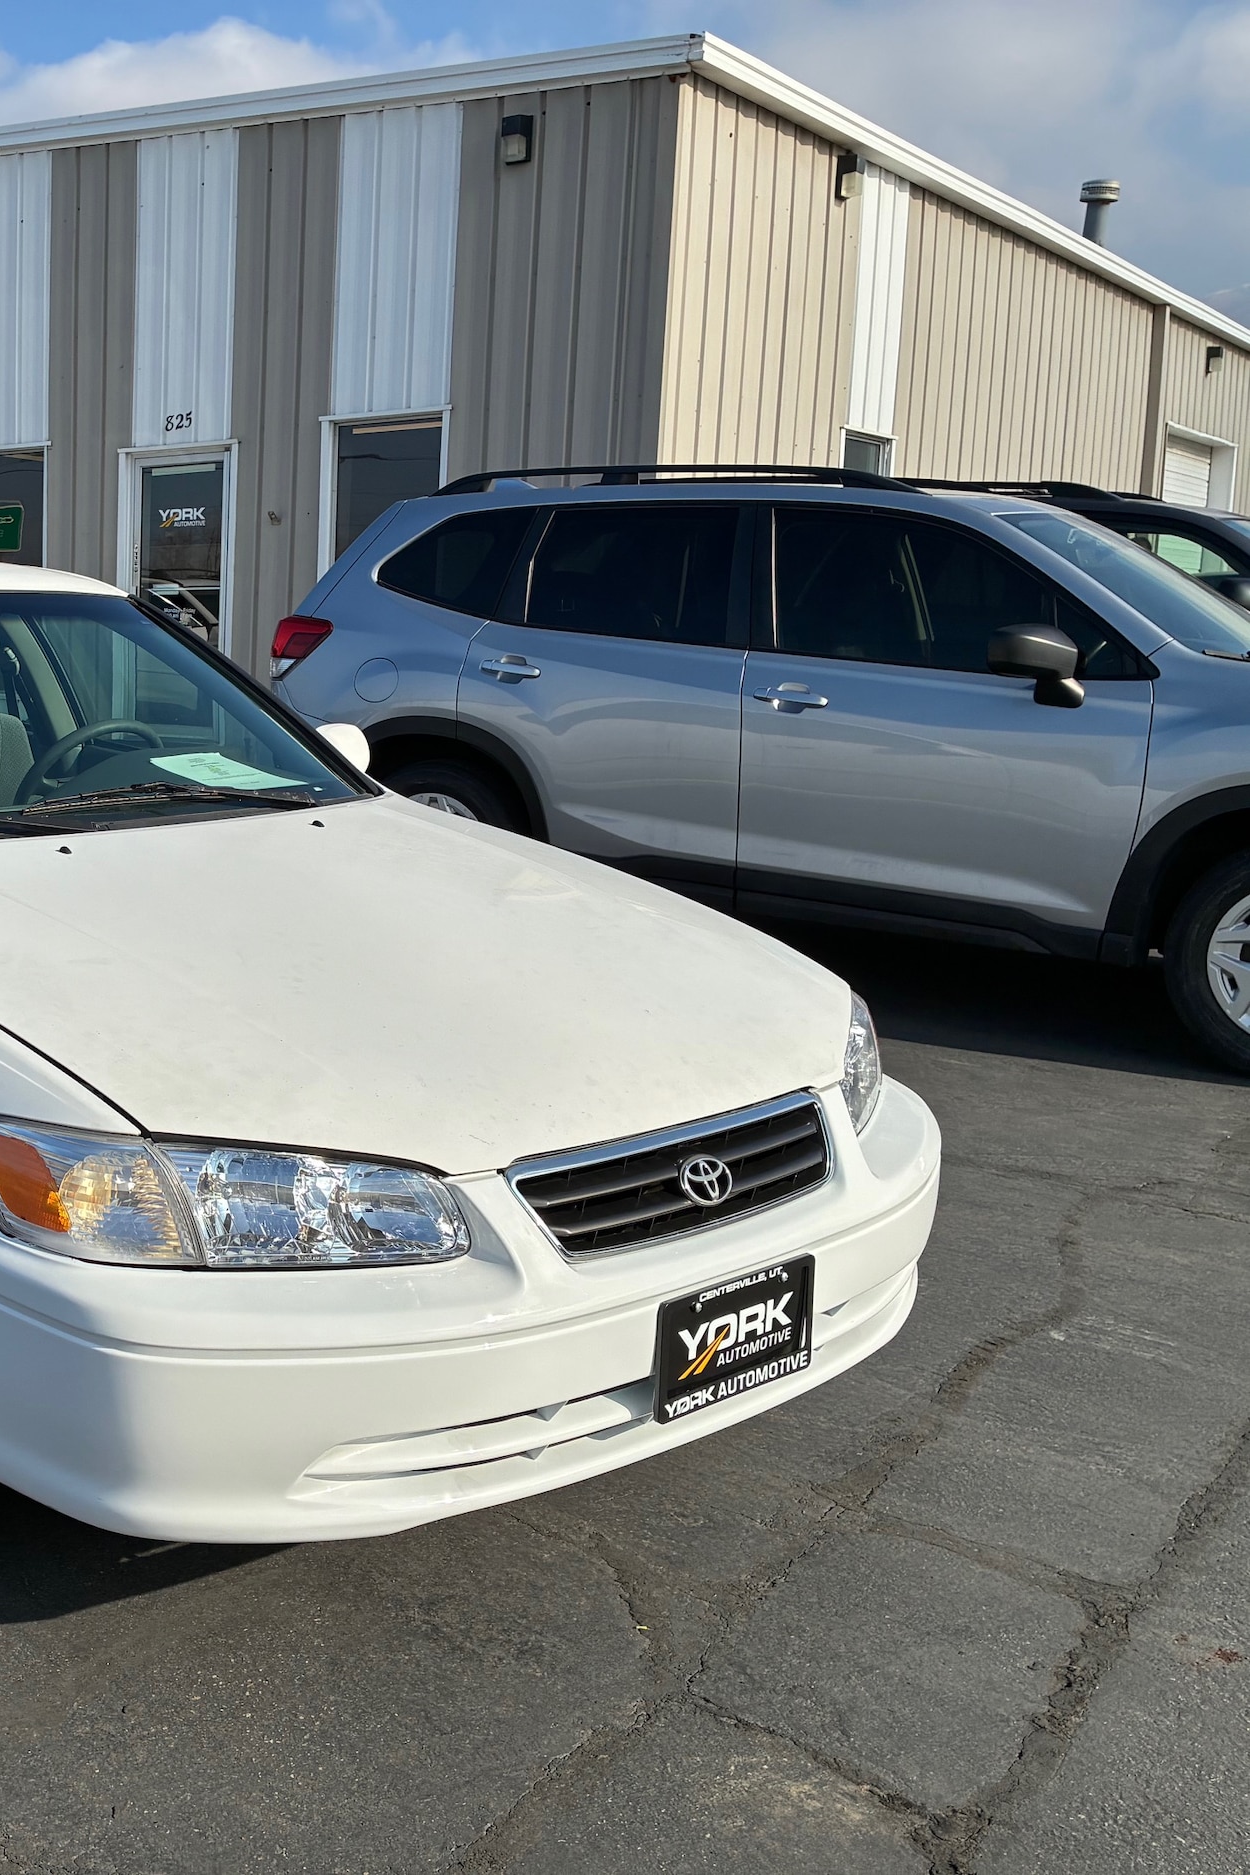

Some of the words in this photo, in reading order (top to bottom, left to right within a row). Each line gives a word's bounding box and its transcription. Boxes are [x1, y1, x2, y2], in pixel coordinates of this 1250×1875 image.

[165, 411, 192, 432] 825
[158, 507, 206, 521] YORK
[699, 1272, 767, 1302] CENTERVILLE,
[678, 1291, 794, 1361] YORK
[716, 1326, 792, 1367] AUTOMOTIVE
[664, 1385, 717, 1418] YORK
[717, 1350, 808, 1399] AUTOMOTIVE
